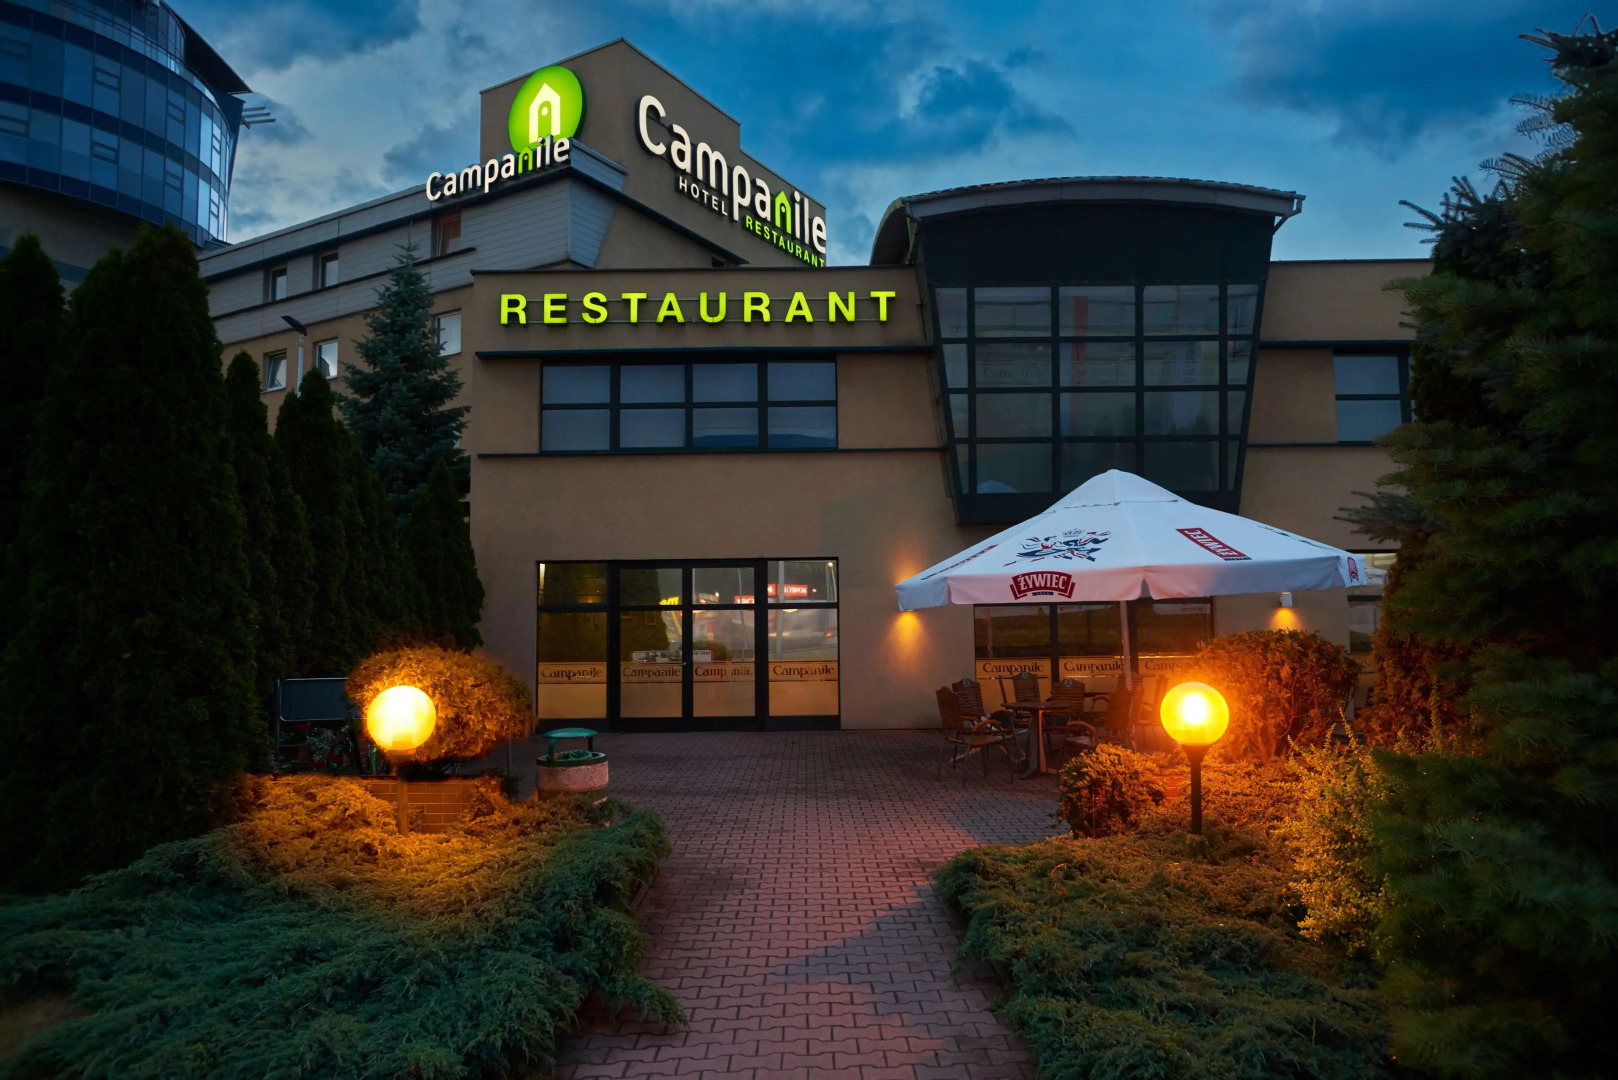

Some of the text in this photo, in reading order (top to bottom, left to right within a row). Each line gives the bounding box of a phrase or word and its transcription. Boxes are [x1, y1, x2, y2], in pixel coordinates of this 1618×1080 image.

[426, 134, 570, 201] Campanile
[638, 95, 827, 253] Campanile
[679, 175, 728, 216] HOTEL
[745, 215, 825, 267] RESTAURANT
[500, 291, 896, 325] RESTAURANT
[1184, 529, 1239, 556] ŻYWIEC
[1017, 573, 1067, 591] ŻYWIEC
[542, 667, 603, 680] Campanile
[622, 667, 681, 678] Campanile
[982, 662, 1044, 674] Campanile
